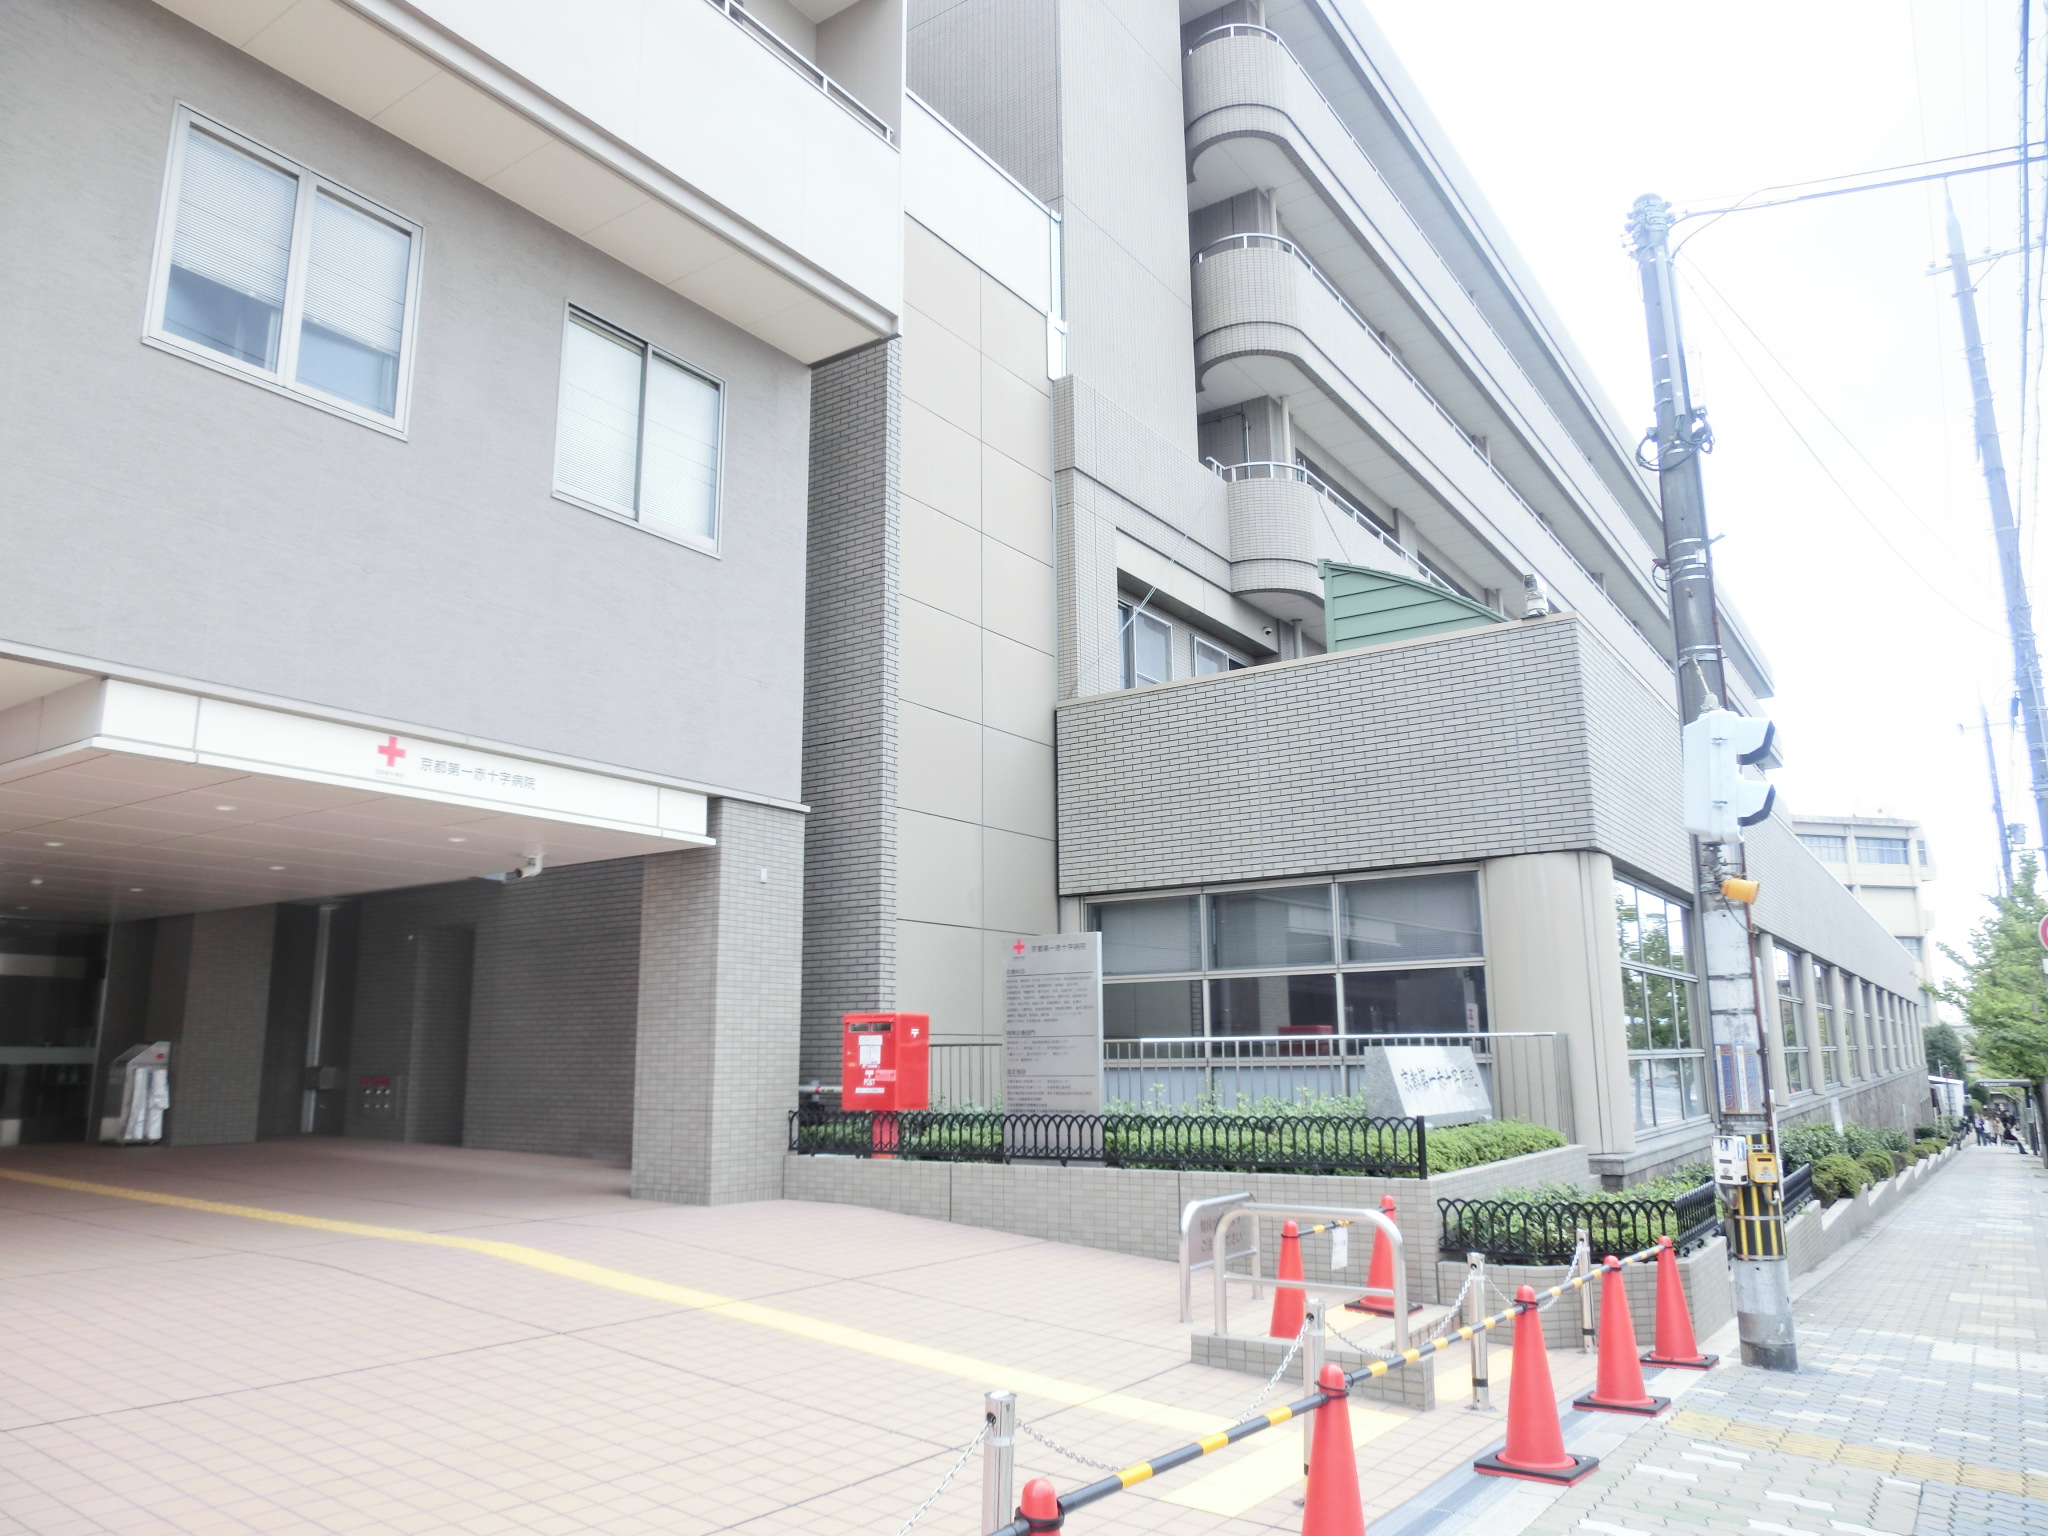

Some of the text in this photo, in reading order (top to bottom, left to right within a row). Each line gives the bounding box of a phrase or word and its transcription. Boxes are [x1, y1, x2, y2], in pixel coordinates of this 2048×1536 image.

[420, 757, 536, 790] 京都第一赤十字病院
